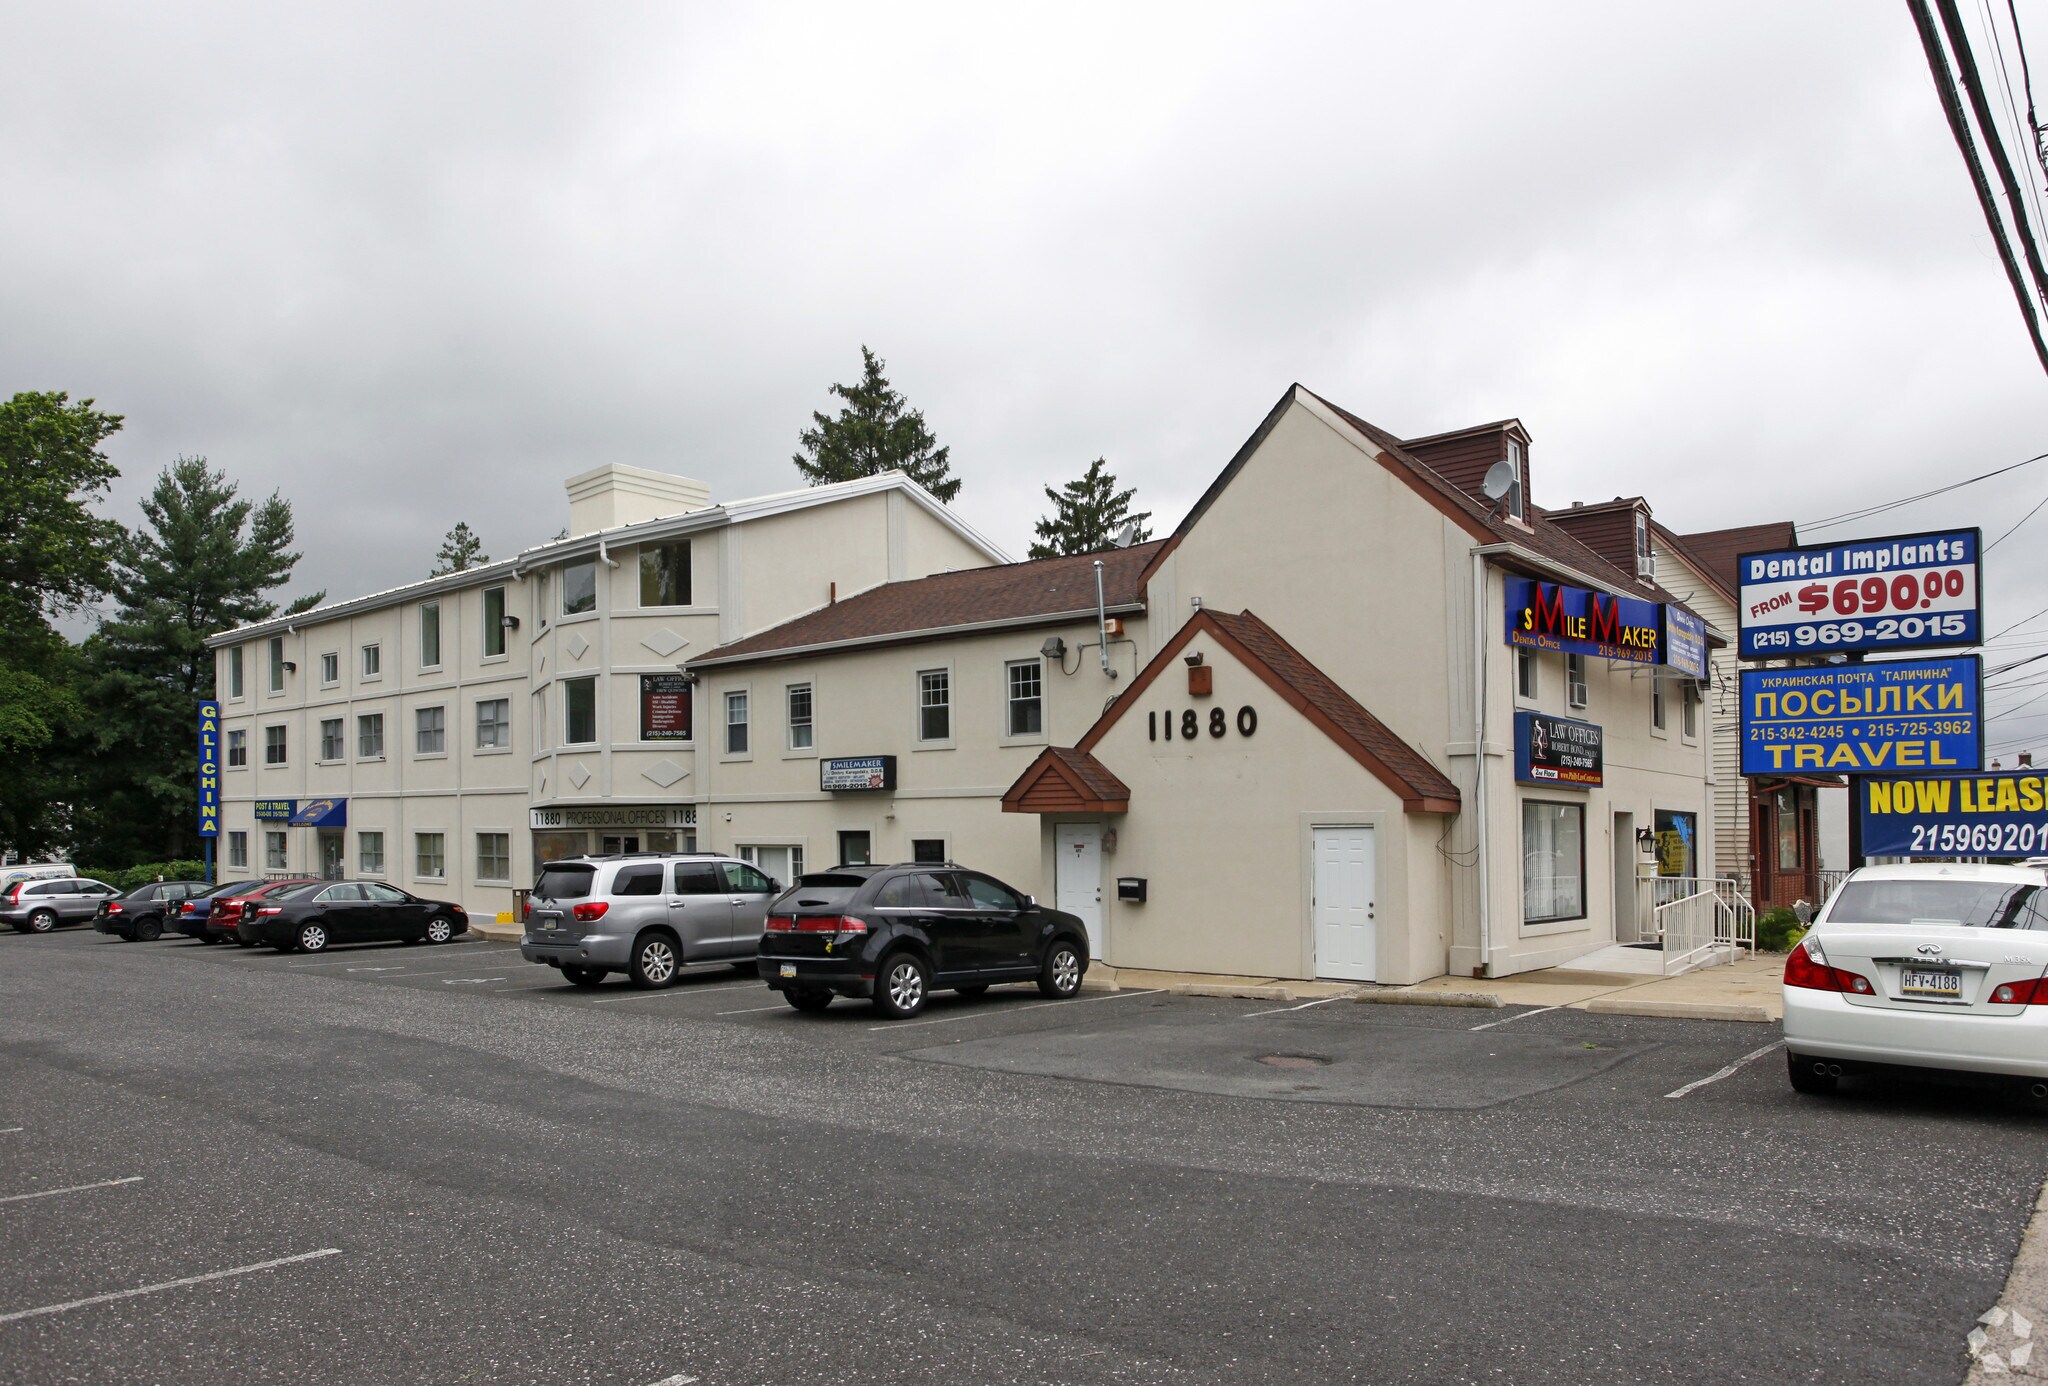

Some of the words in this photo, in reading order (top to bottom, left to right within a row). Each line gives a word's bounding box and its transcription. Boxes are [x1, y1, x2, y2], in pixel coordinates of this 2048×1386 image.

[1750, 552, 1832, 580] Dental
[1843, 540, 1964, 571] Implants
[1750, 592, 1793, 618] FROM
[1753, 631, 1790, 649] (215)
[1794, 614, 1966, 645] 969-2015
[1598, 645, 1653, 662] 215-969-2015
[1762, 675, 1834, 688] УКРАИНСКАЯ
[1837, 672, 1875, 685] ПОЧТА
[1881, 667, 1952, 682] "ГАЛИЧИНА"
[1755, 683, 1963, 717] ПОСЫЛКИ
[1149, 705, 1258, 742] 11880
[1549, 722, 1567, 740] LAW
[1568, 726, 1599, 746] OFFICES
[1751, 725, 1844, 741] 215-342-4245
[1868, 721, 1971, 736] 215-725-3962
[1551, 741, 1570, 753] ROBERT
[1764, 740, 1957, 769] TRAVEL
[201, 705, 217, 831] GALICHINA
[832, 760, 882, 769] SMILEMAKER
[1560, 754, 1593, 769] (215)-240-7565
[256, 802, 268, 810] POST
[272, 802, 290, 810] TRAVEL
[1869, 780, 1951, 814] NOW
[534, 812, 561, 825] 11880
[567, 810, 627, 825] PROFESSIONAL
[629, 809, 666, 824] OFFICES
